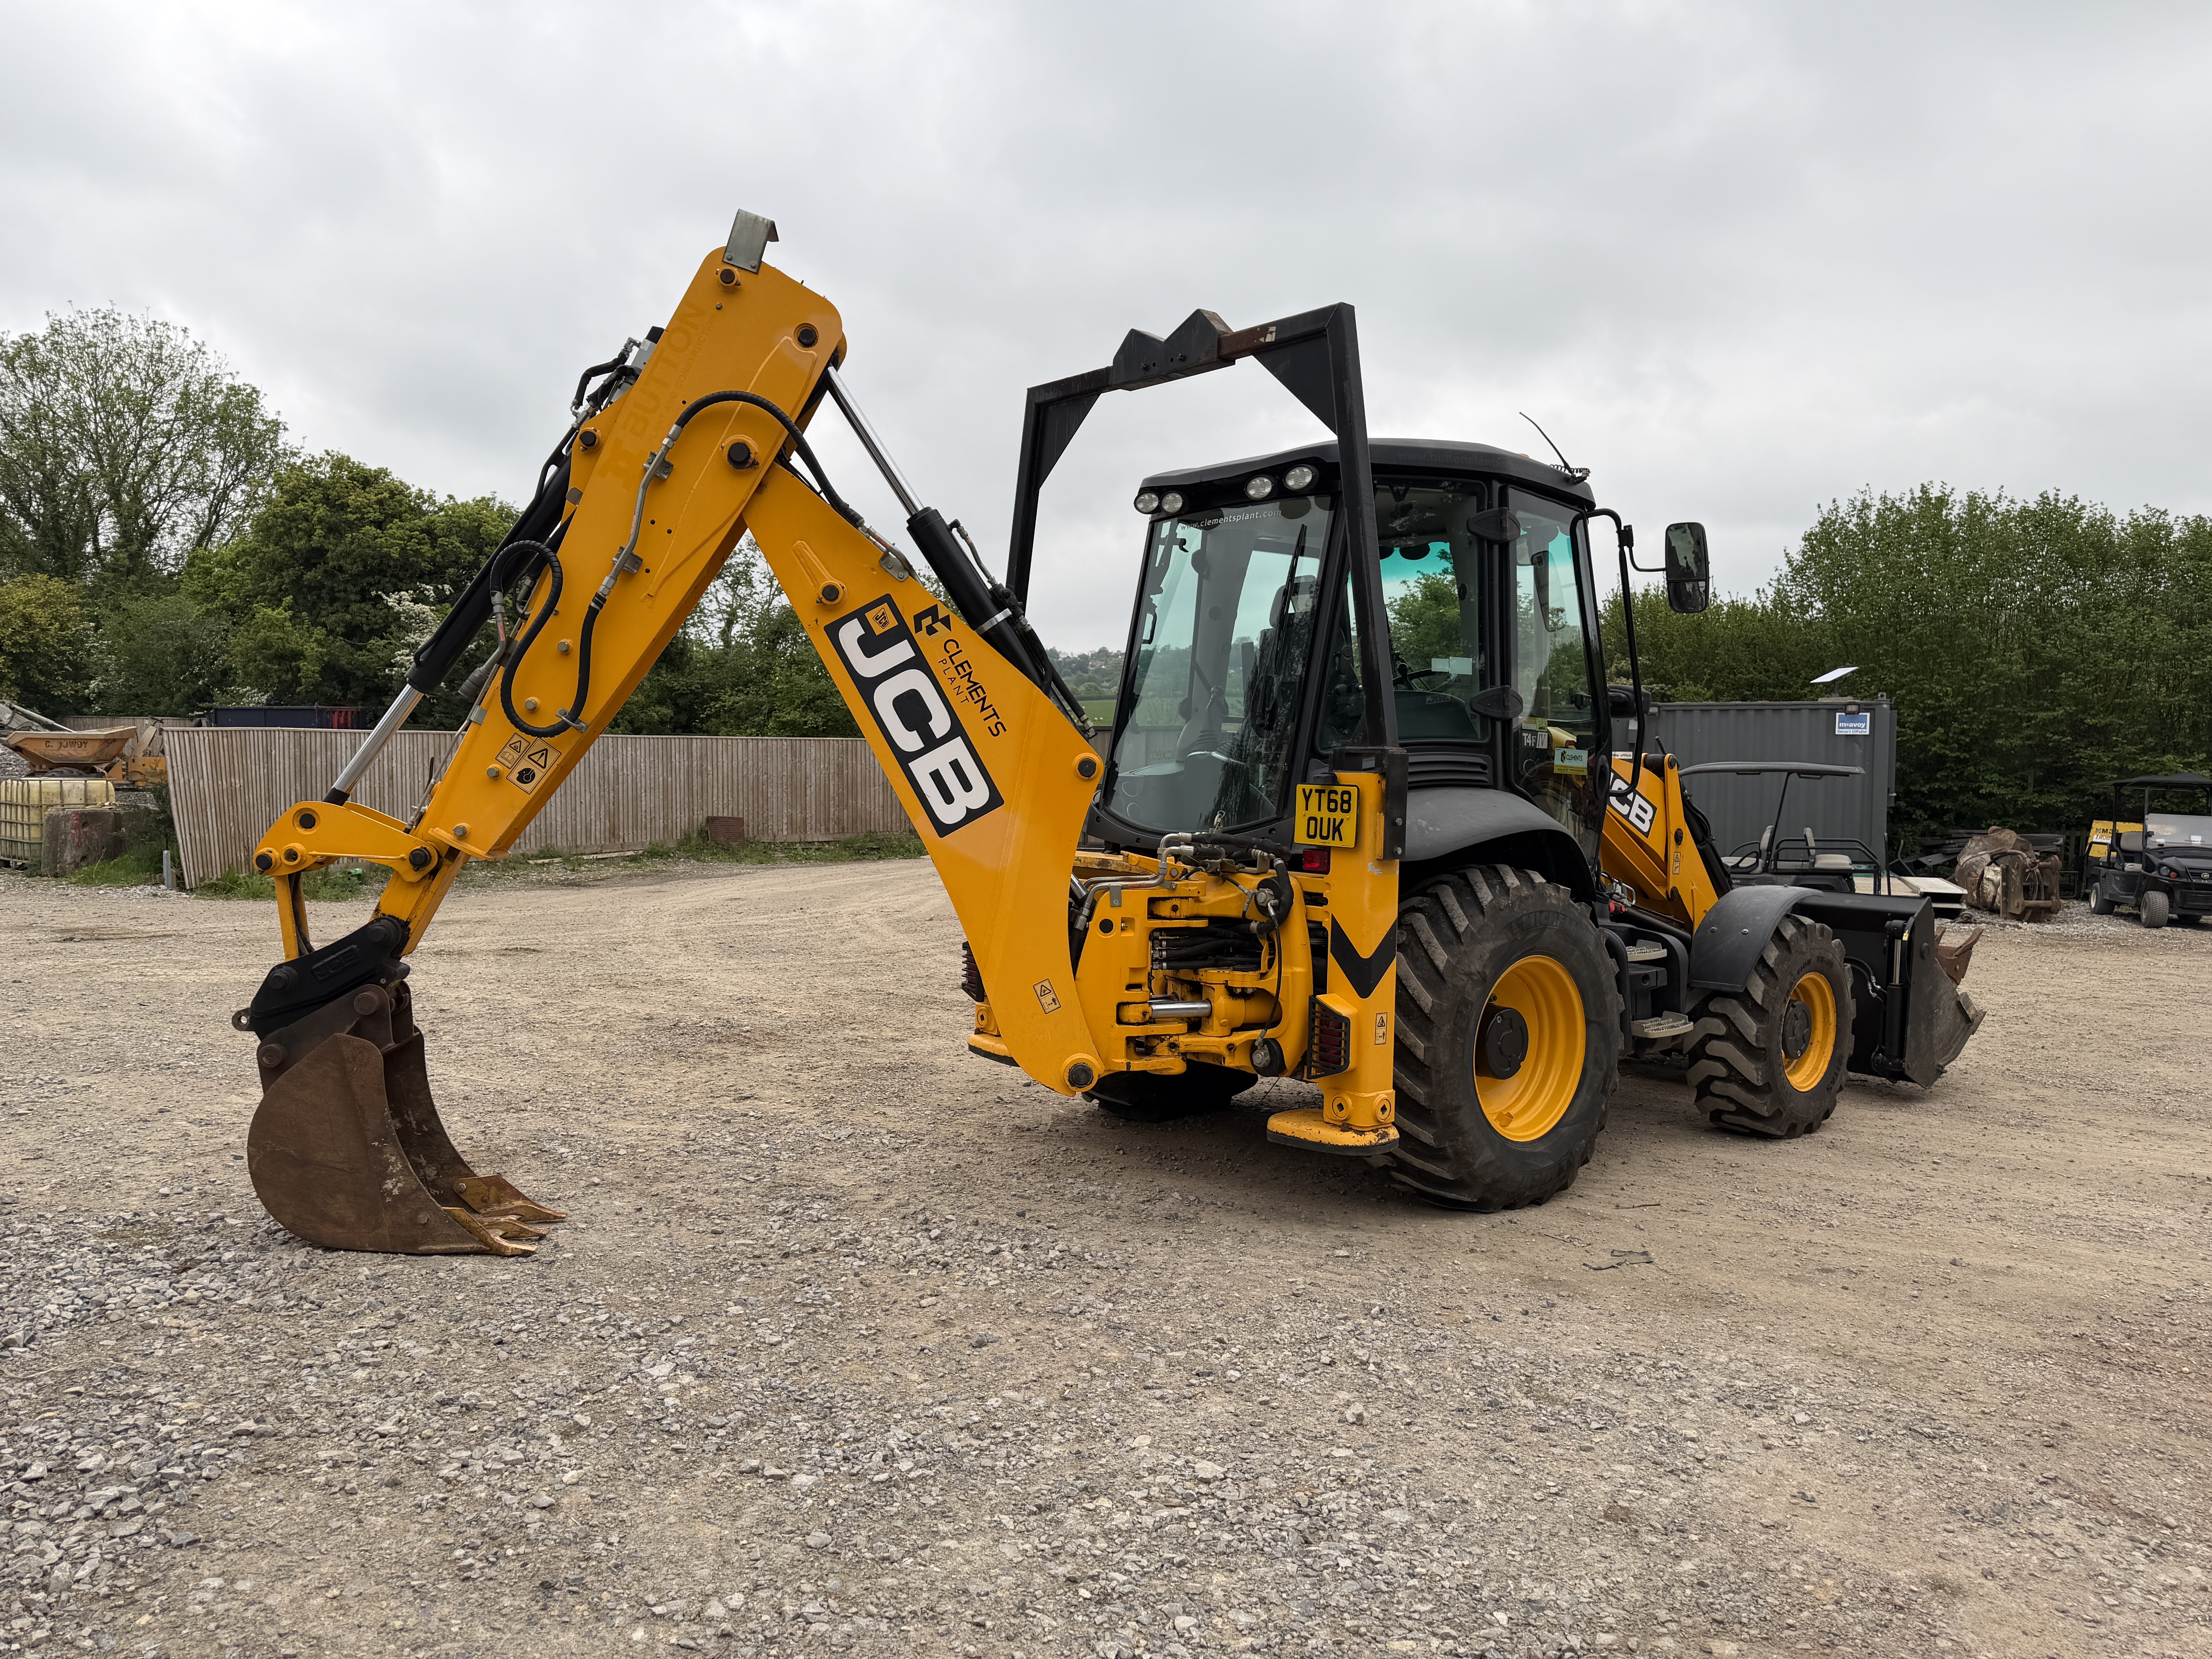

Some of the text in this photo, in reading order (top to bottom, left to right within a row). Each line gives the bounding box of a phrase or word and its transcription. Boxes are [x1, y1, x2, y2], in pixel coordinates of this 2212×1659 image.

[622, 300, 706, 438] BUTTON
[1181, 510, 1281, 530] www.clementsplant.com
[874, 611, 888, 627] JCB
[938, 659, 969, 703] PLANT
[943, 638, 1007, 737] CLEMENTS
[839, 618, 990, 824] JCB
[1302, 788, 1352, 814] YT68
[1610, 772, 1653, 833] CB
[1306, 816, 1344, 842] OUK
[313, 948, 359, 980] JCB
